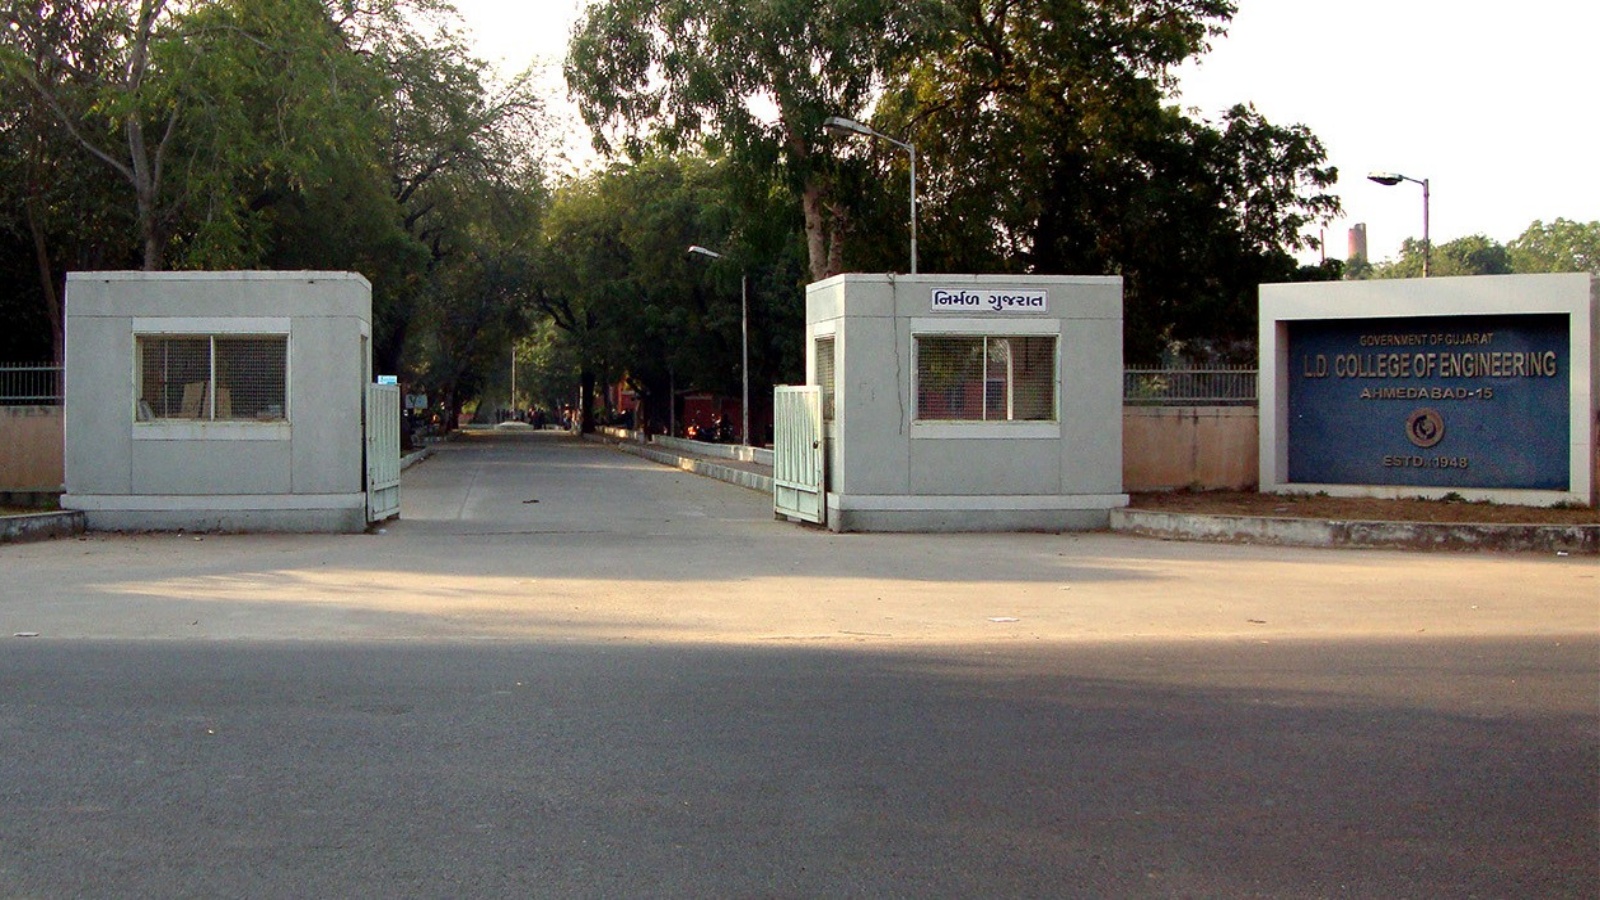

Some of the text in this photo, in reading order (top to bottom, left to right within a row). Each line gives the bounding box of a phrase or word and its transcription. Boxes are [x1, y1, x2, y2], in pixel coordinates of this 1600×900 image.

[934, 291, 1043, 311] નિર્મળ ગુજરાત
[1360, 332, 1493, 346] GOVERNMENT OF GUJARAT
[1304, 351, 1556, 378] L.D. COLLEGE OF ENGINEERING
[1360, 387, 1493, 399] AHMEDABAD-15
